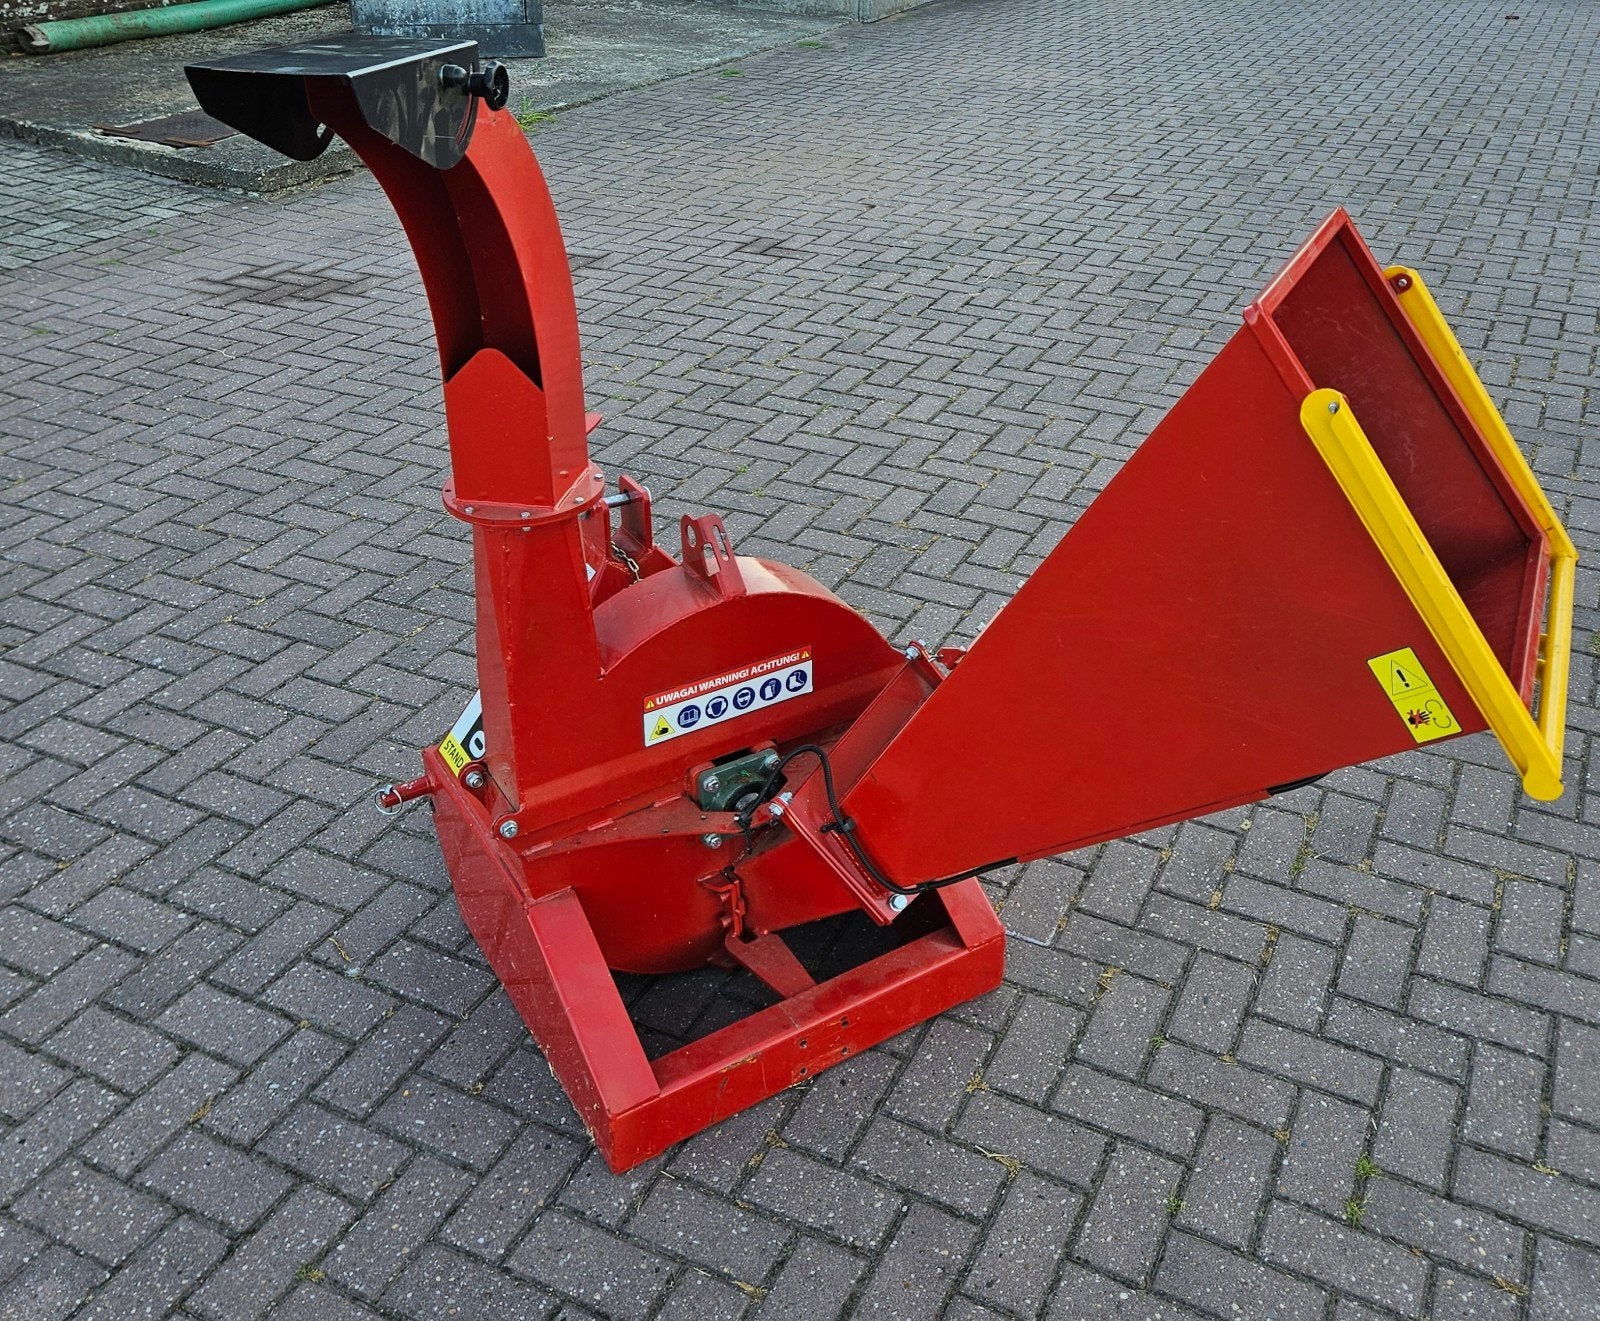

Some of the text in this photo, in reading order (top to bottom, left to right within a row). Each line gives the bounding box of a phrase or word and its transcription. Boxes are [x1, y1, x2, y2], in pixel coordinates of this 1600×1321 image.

[656, 652, 800, 705] UWAGA! WARNING! ACHTUNG!
[444, 740, 464, 768] STAND
